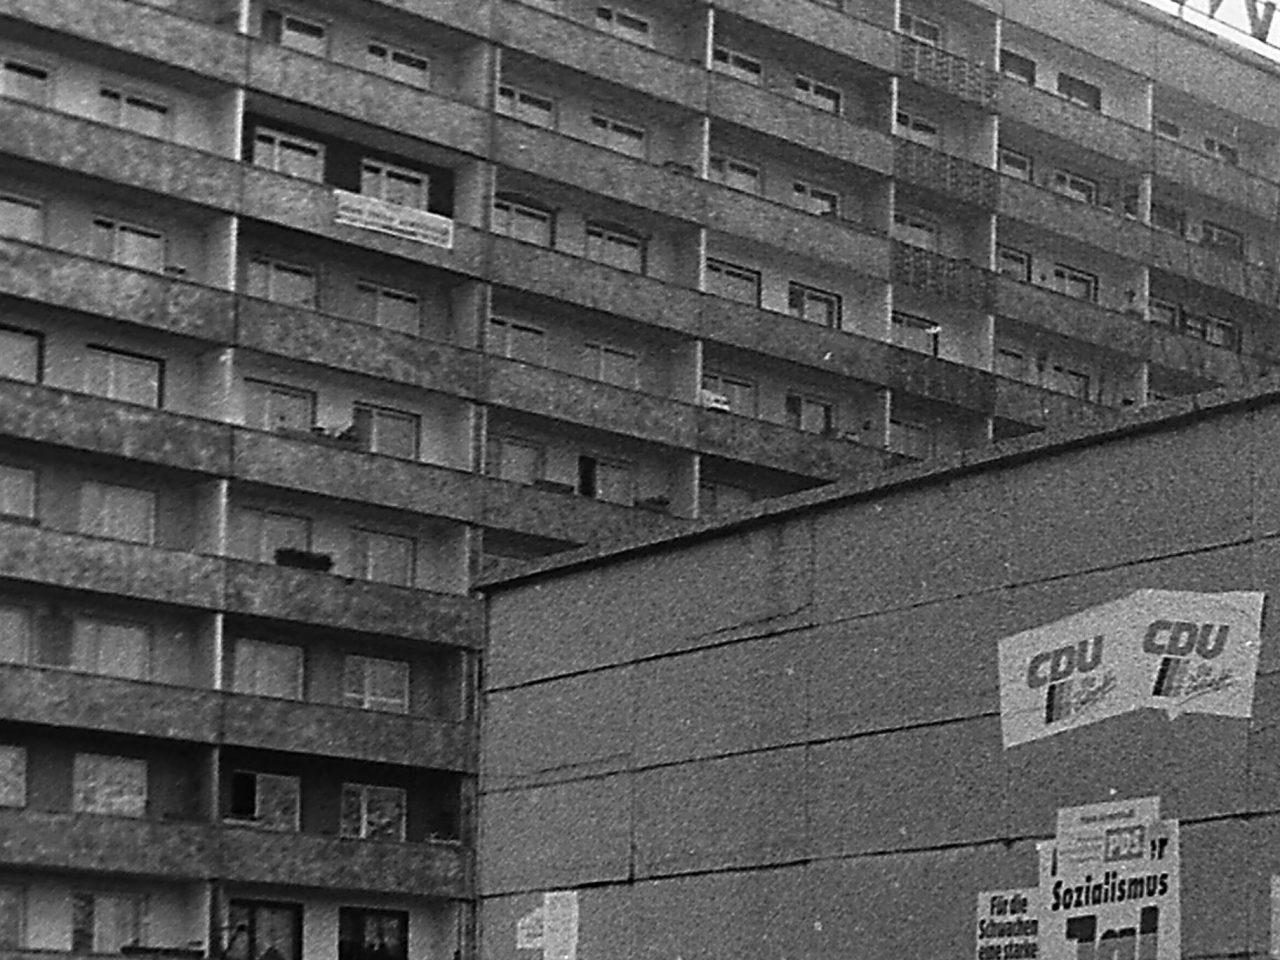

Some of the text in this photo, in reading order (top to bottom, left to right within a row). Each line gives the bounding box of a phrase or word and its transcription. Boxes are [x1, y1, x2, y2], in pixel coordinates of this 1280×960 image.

[1143, 619, 1230, 660] CDU
[1027, 635, 1103, 689] CDU
[1052, 871, 1168, 911] Sozialismus
